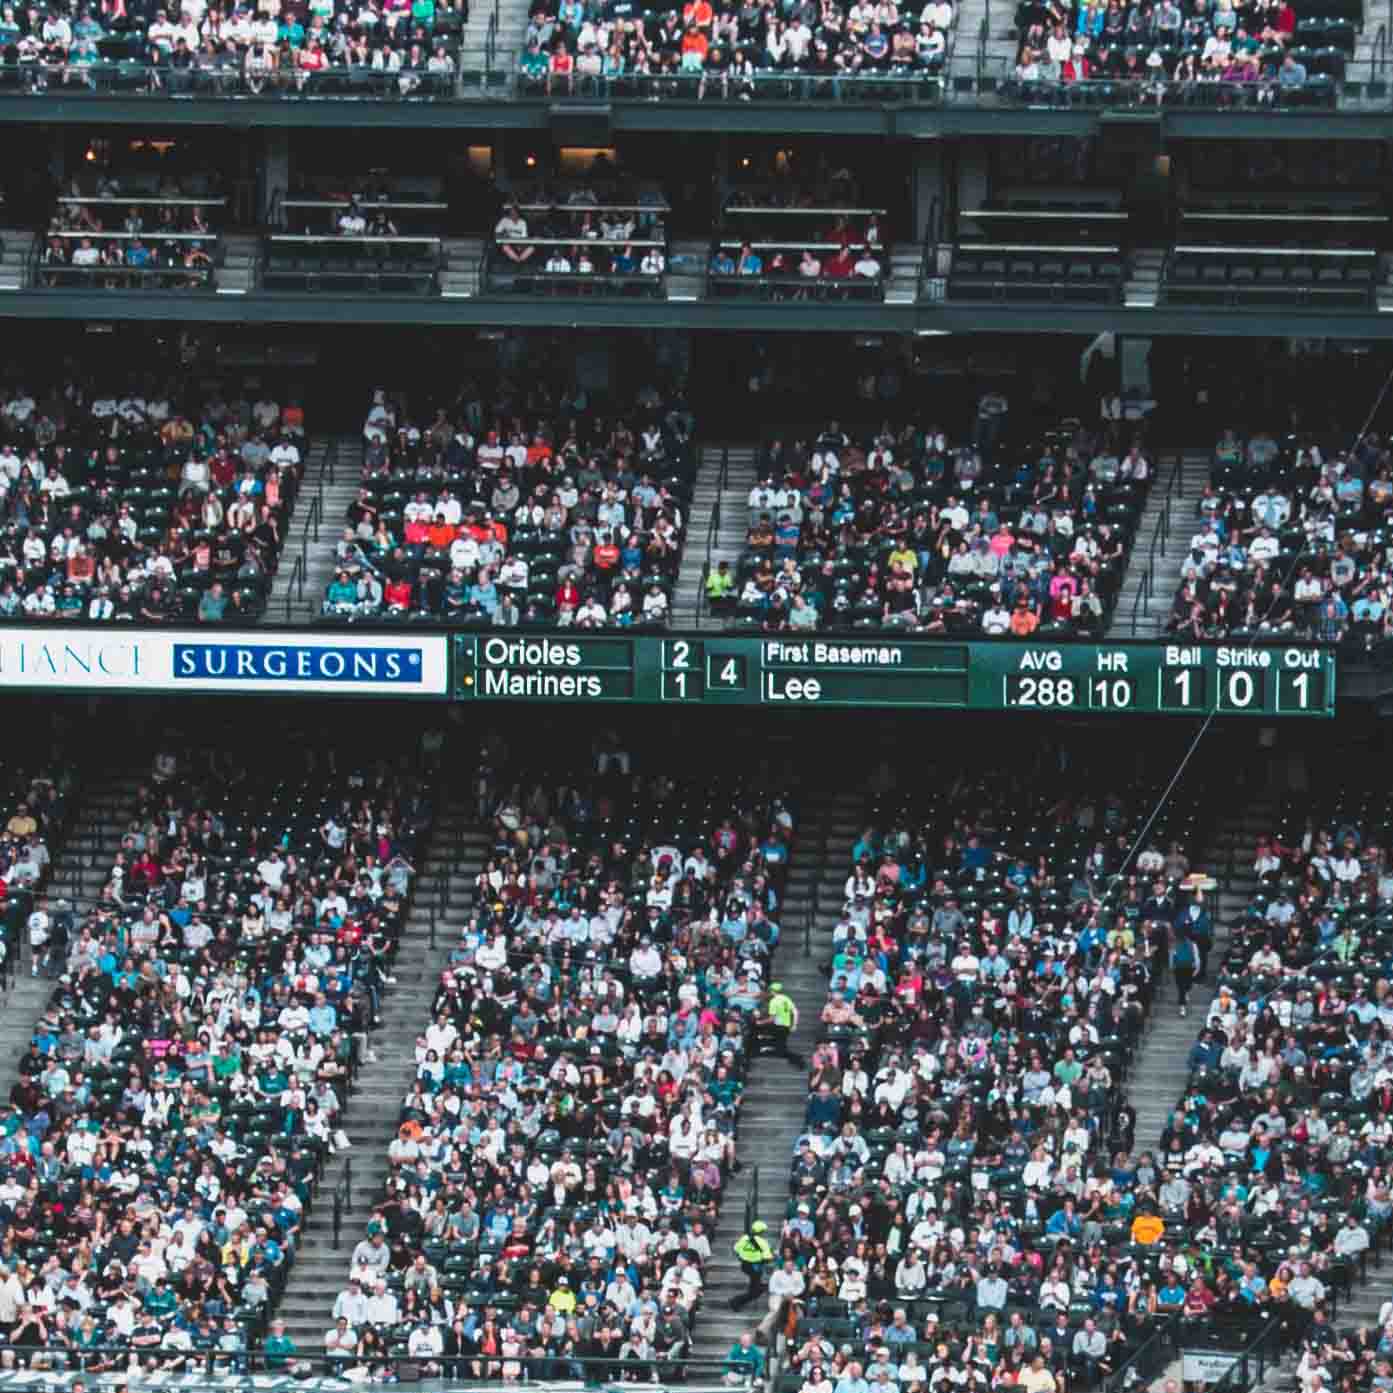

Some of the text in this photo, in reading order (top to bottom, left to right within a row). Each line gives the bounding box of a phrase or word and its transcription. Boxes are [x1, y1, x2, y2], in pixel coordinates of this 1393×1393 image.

[0, 642, 402, 678] IANCE SURGEONS
[484, 637, 582, 666] Orioles
[671, 640, 690, 668] 2
[767, 643, 902, 665] First Baseman
[1019, 651, 1063, 671] AVG
[1097, 652, 1128, 672] HR
[1165, 646, 1202, 666] Ball
[1216, 647, 1272, 668] Strike
[1284, 650, 1321, 669] Out
[484, 669, 602, 697] Mariners
[674, 672, 687, 699] 1
[720, 658, 738, 685] 4
[767, 672, 822, 701] Lee
[1010, 677, 1075, 706] .288
[1095, 680, 1131, 708] 10
[1174, 669, 1191, 707] 1
[1228, 671, 1254, 707] 0
[1291, 672, 1309, 709] 1
